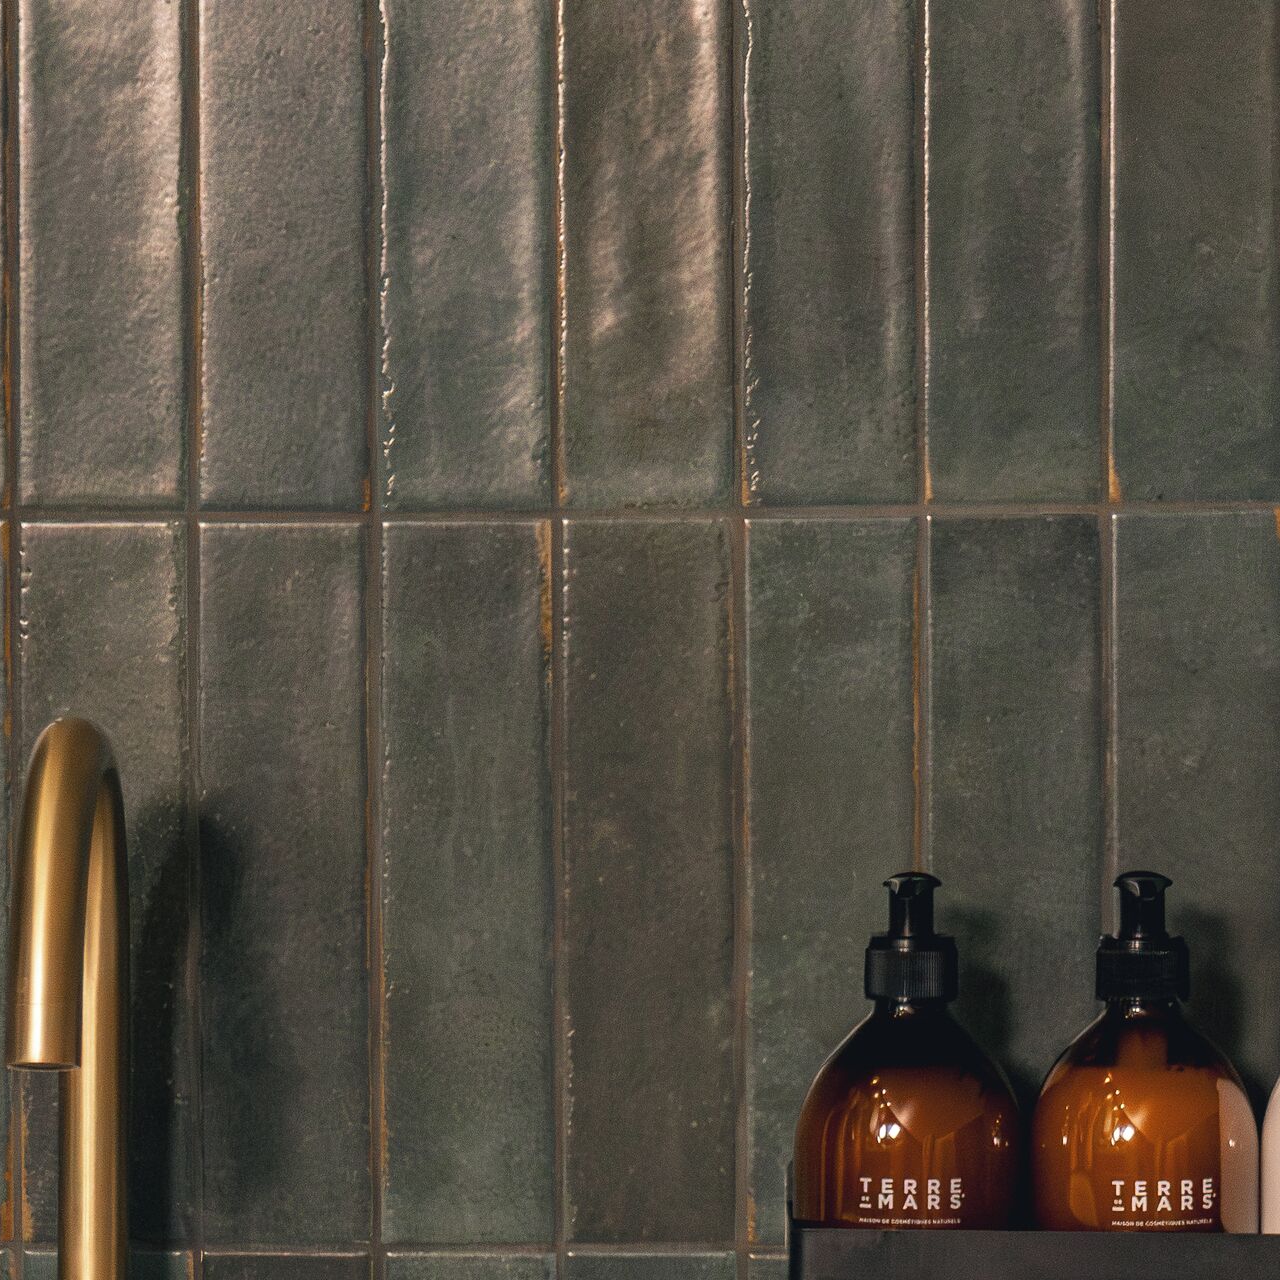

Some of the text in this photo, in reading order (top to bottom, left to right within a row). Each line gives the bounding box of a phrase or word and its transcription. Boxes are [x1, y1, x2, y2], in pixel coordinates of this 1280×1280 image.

[859, 1177, 963, 1195] TERRE
[1111, 1178, 1214, 1197] TERRE
[877, 1194, 963, 1210] MARS
[1131, 1194, 1214, 1212] MARS
